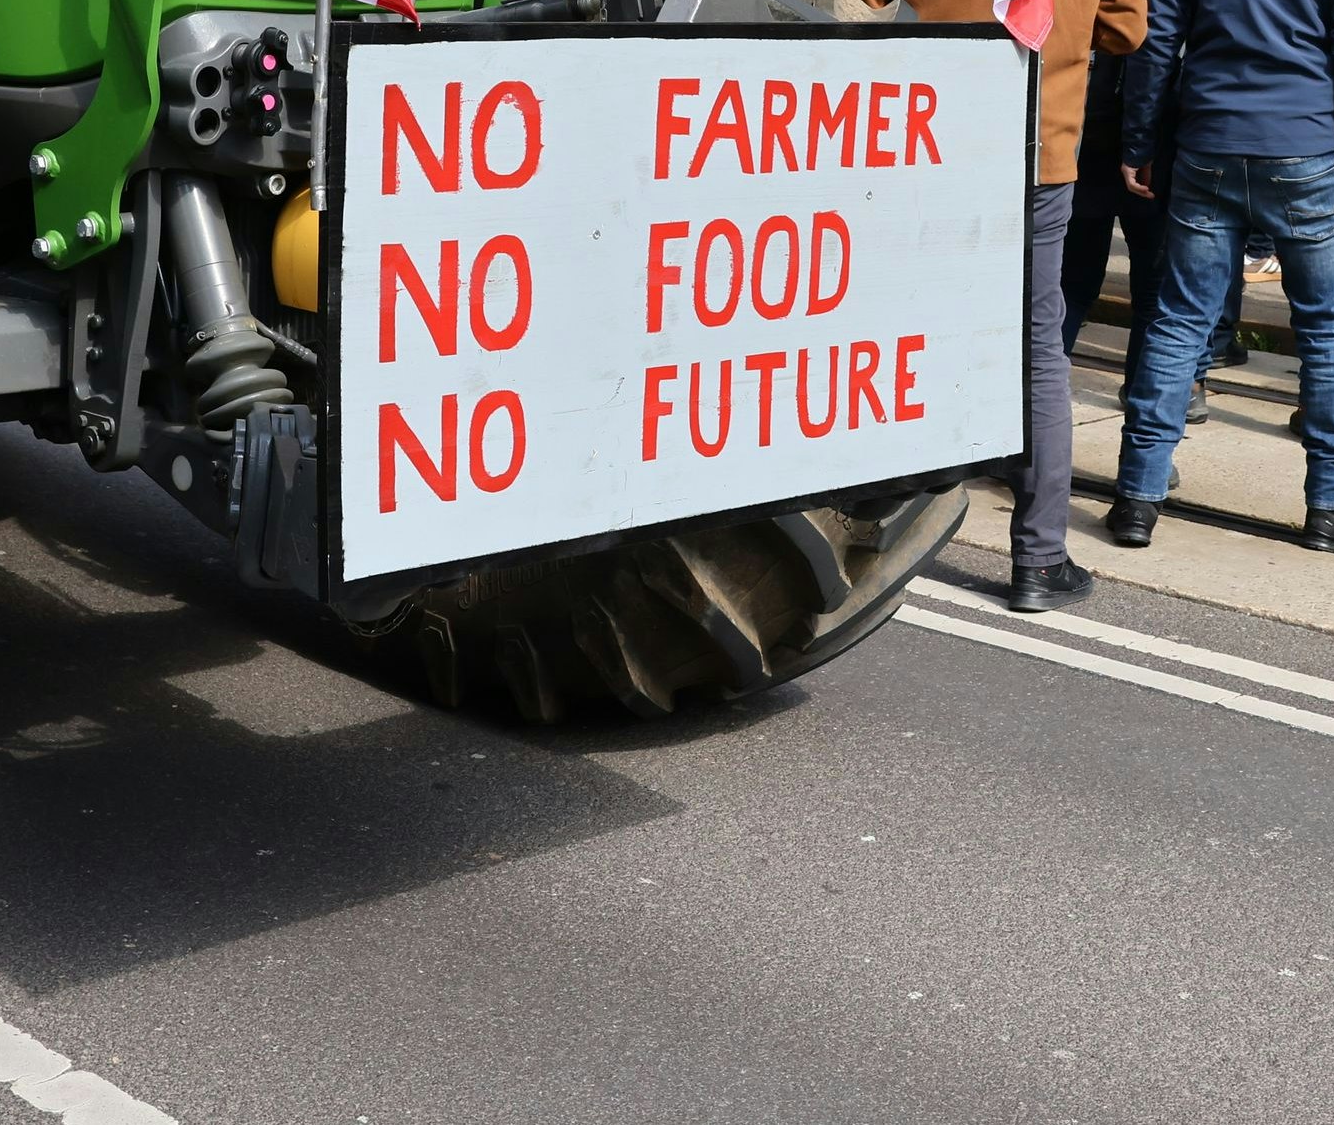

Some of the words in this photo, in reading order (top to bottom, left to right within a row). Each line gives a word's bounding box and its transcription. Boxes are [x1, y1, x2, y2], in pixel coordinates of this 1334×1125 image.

[382, 81, 543, 195] NO
[655, 79, 941, 179] FARMER
[380, 235, 532, 362] NO
[647, 211, 851, 333] FOOD
[379, 390, 526, 513] NO
[643, 335, 925, 461] FUTURE
